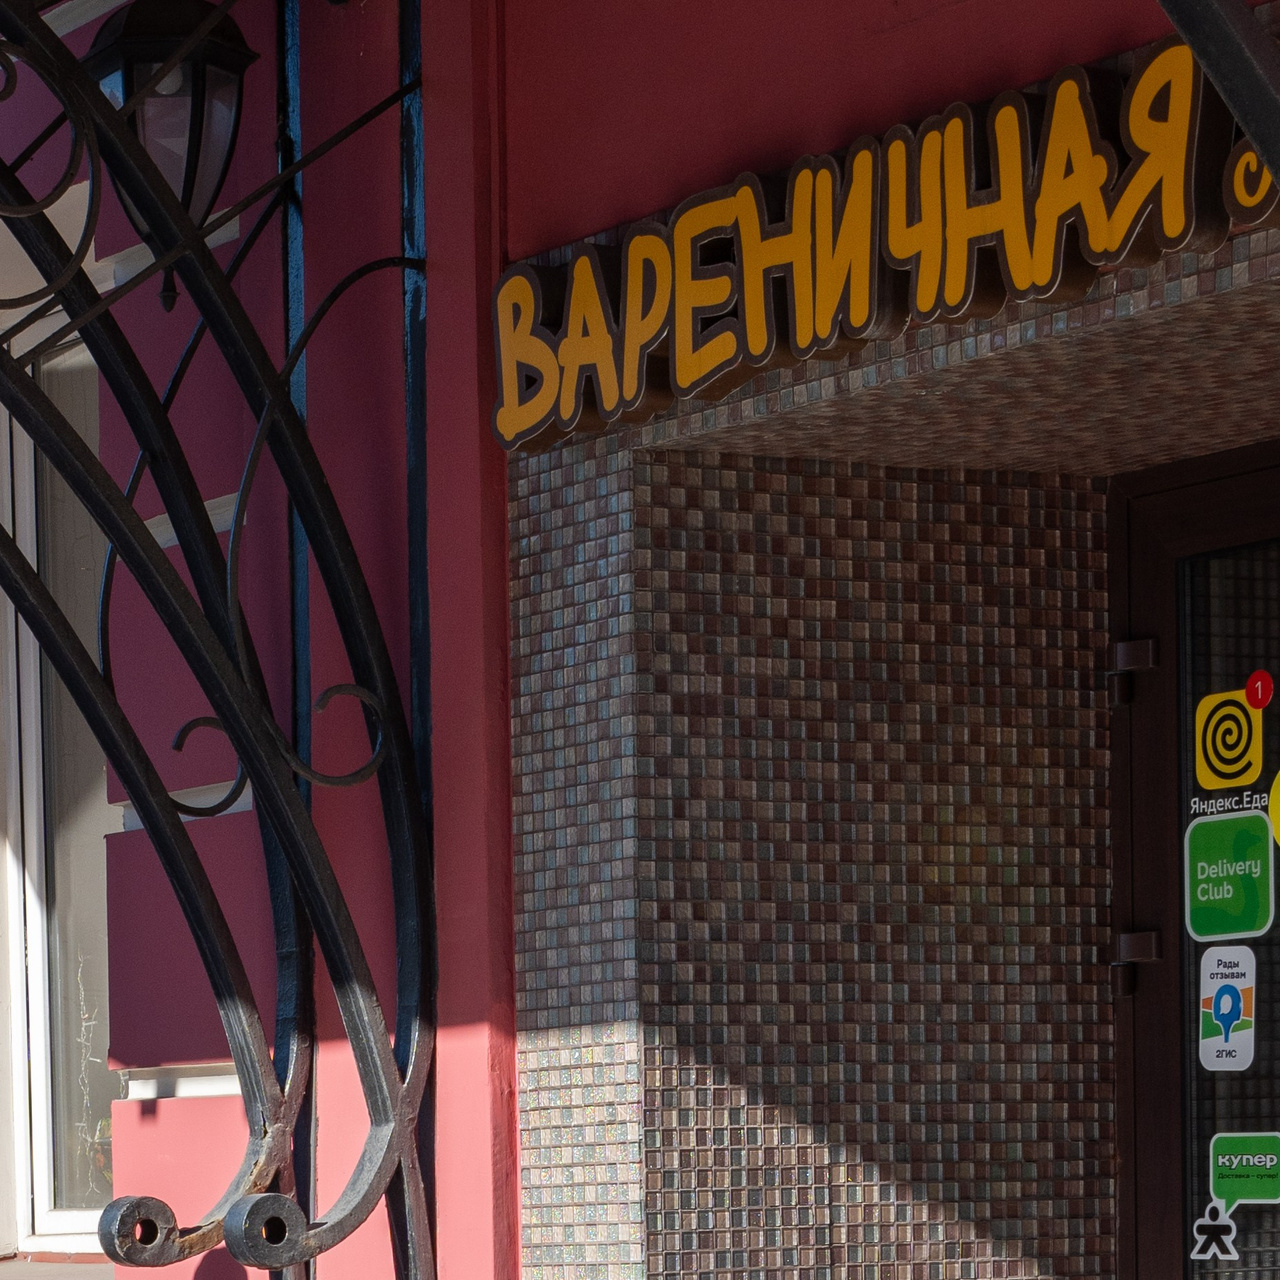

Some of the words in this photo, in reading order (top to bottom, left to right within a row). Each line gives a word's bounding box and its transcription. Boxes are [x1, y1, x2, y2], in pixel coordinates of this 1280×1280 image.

[494, 43, 1196, 443] ВАРЕНИЧНАЯ
[1254, 680, 1263, 700] 1
[1190, 791, 1269, 814] Яндекс.Еда
[1197, 859, 1262, 879] Delivery
[1197, 882, 1234, 901] Club
[1216, 959, 1240, 970] Рады
[1209, 971, 1247, 980] отзывам
[1215, 1049, 1238, 1059] 2ГИС
[1218, 1154, 1278, 1170] купер
